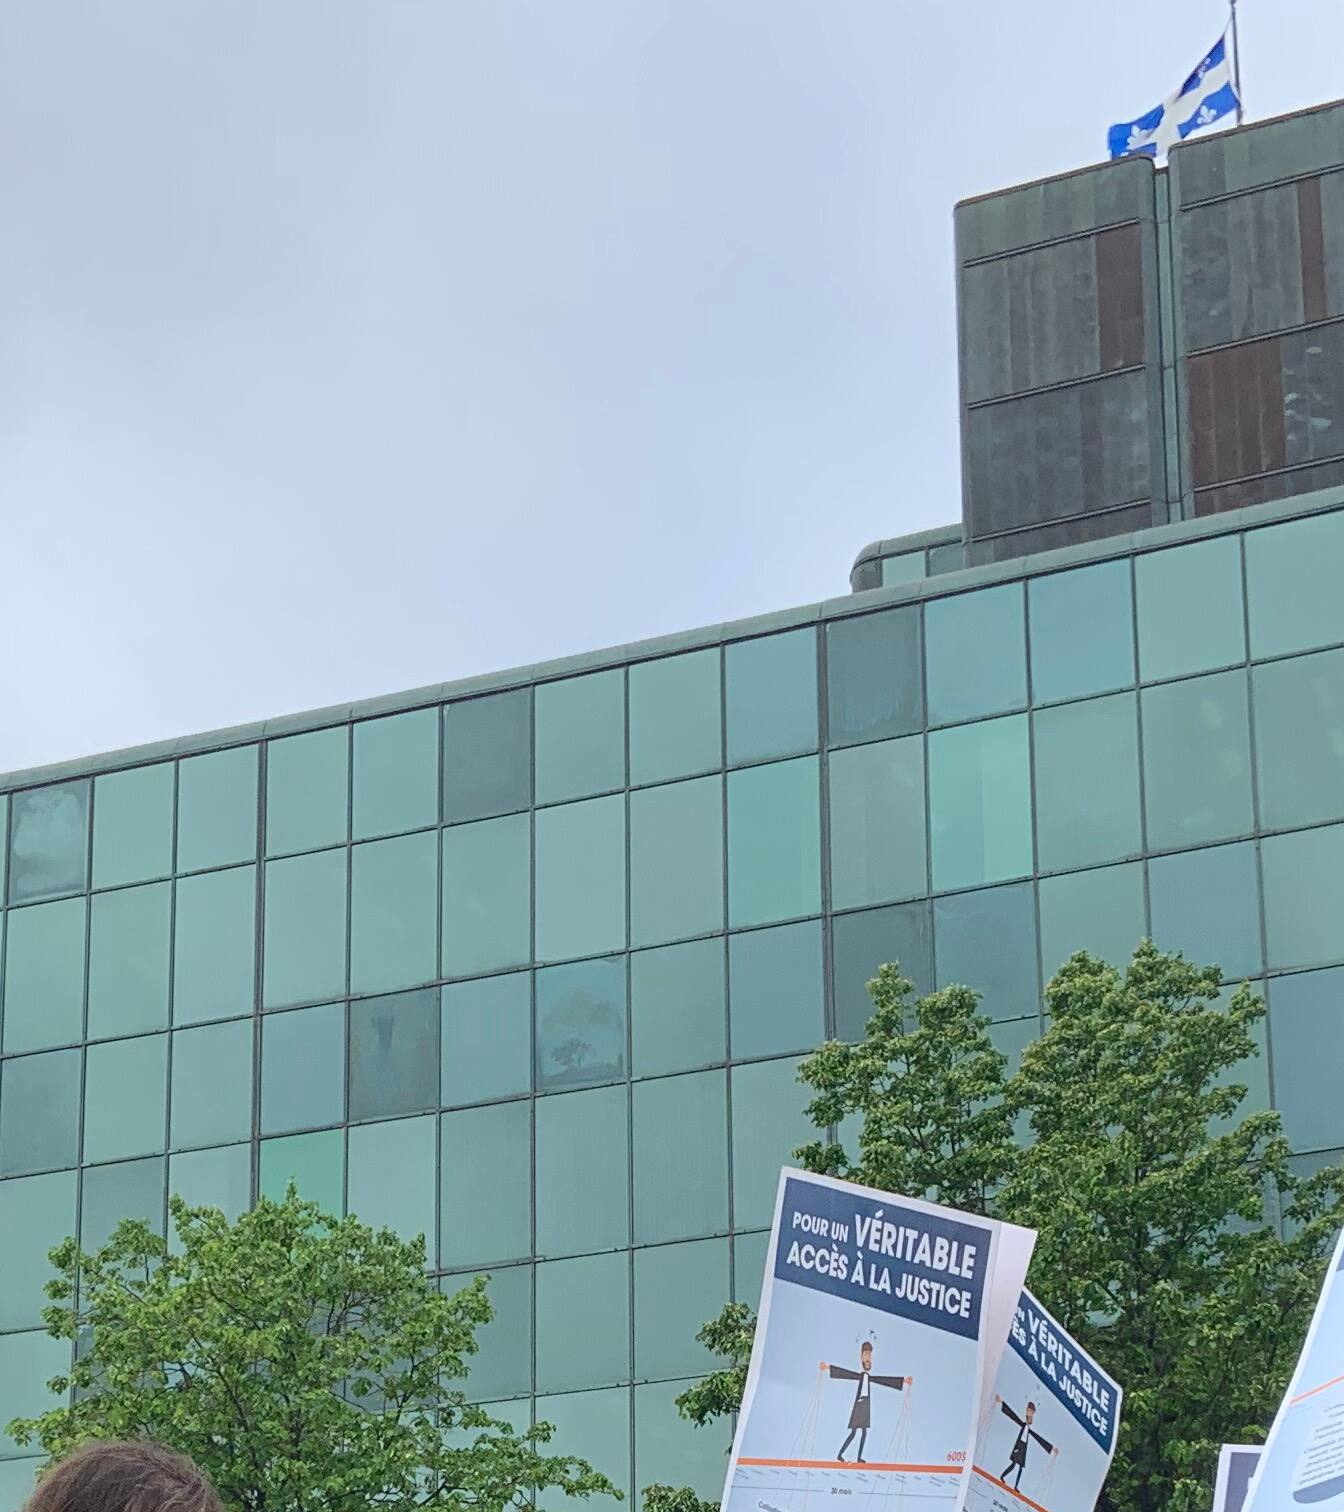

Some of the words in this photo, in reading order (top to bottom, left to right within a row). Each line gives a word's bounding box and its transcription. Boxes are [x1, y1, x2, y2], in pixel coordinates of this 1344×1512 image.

[786, 1241, 847, 1279] ACCÈS
[851, 1251, 864, 1285] À
[869, 1264, 890, 1293] LA
[895, 1273, 970, 1317] JUSTICE
[792, 1211, 828, 1236] POUR
[831, 1222, 848, 1242] UN
[855, 1209, 975, 1278] VÉRITABLE
[1027, 1309, 1110, 1412] VÉRITABLE
[1040, 1352, 1057, 1382] LA
[1058, 1375, 1108, 1436] JUSTICE
